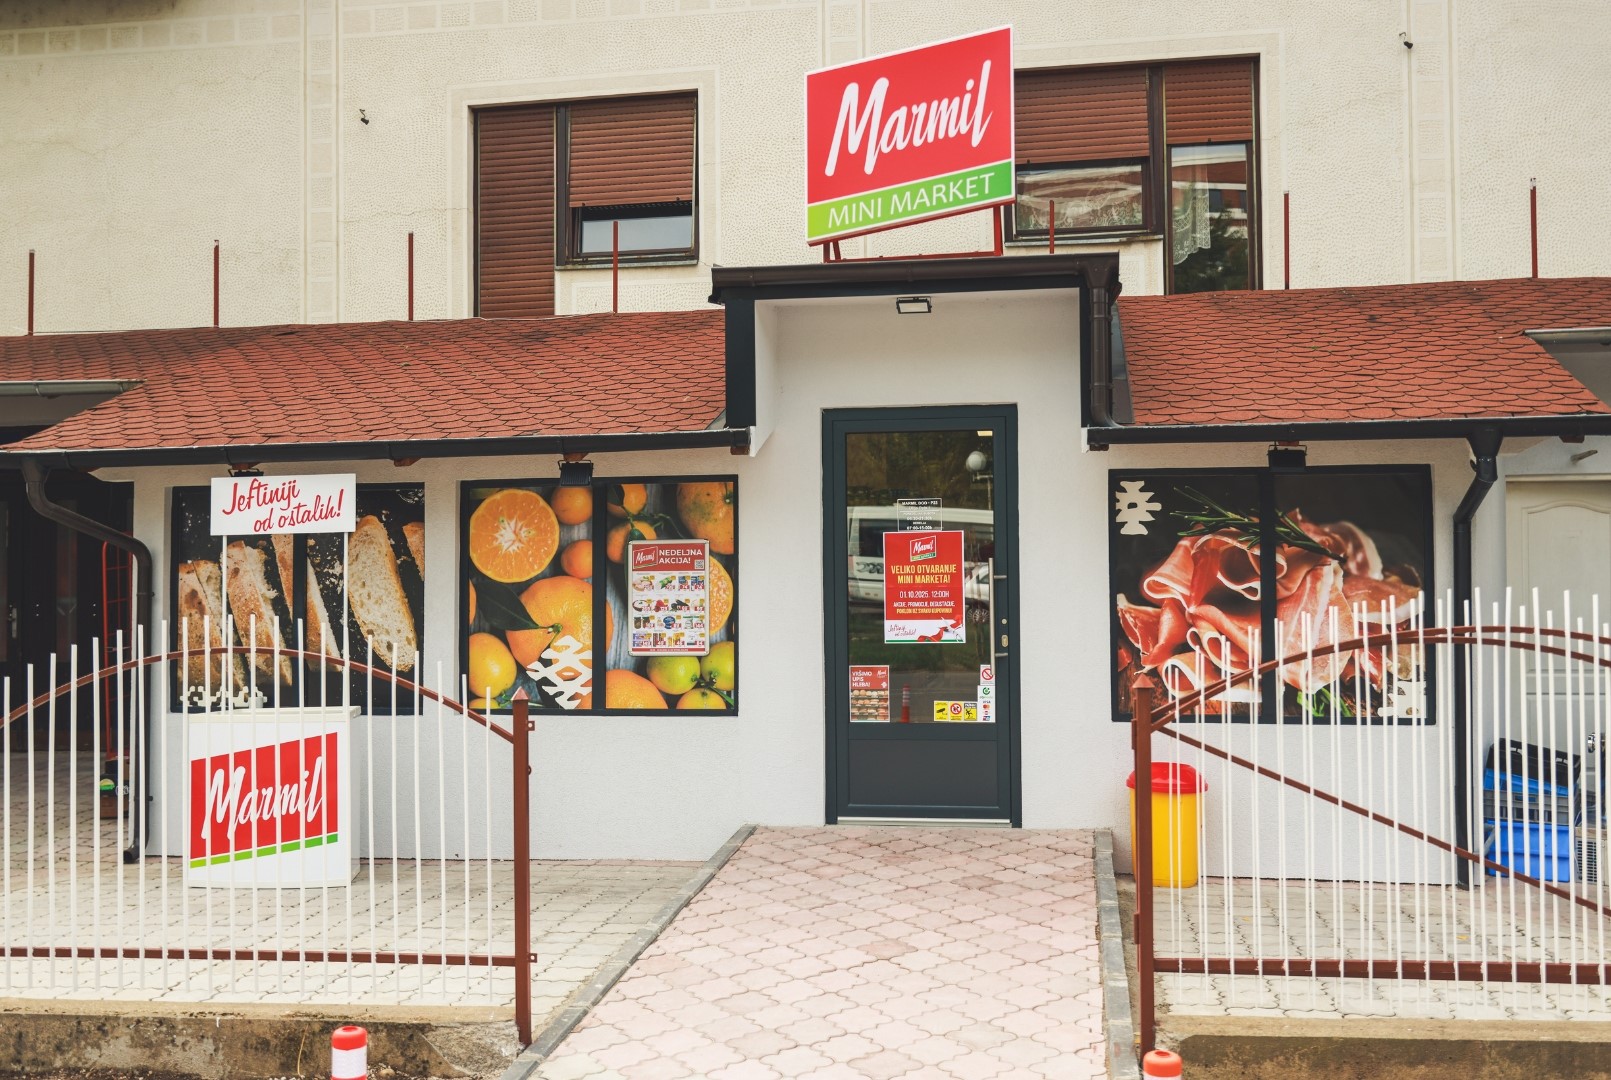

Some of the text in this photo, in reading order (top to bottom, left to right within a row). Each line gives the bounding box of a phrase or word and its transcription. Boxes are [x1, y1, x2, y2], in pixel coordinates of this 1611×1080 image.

[824, 59, 993, 177] Marmil
[828, 172, 995, 229] MINI MARKET
[222, 478, 300, 515] Jeftiniji
[253, 488, 344, 532] od ostalih!
[891, 564, 957, 574] VELIKO OTVARANJE
[898, 574, 951, 584] MINI MARKETA!
[201, 756, 324, 839] Marmil
